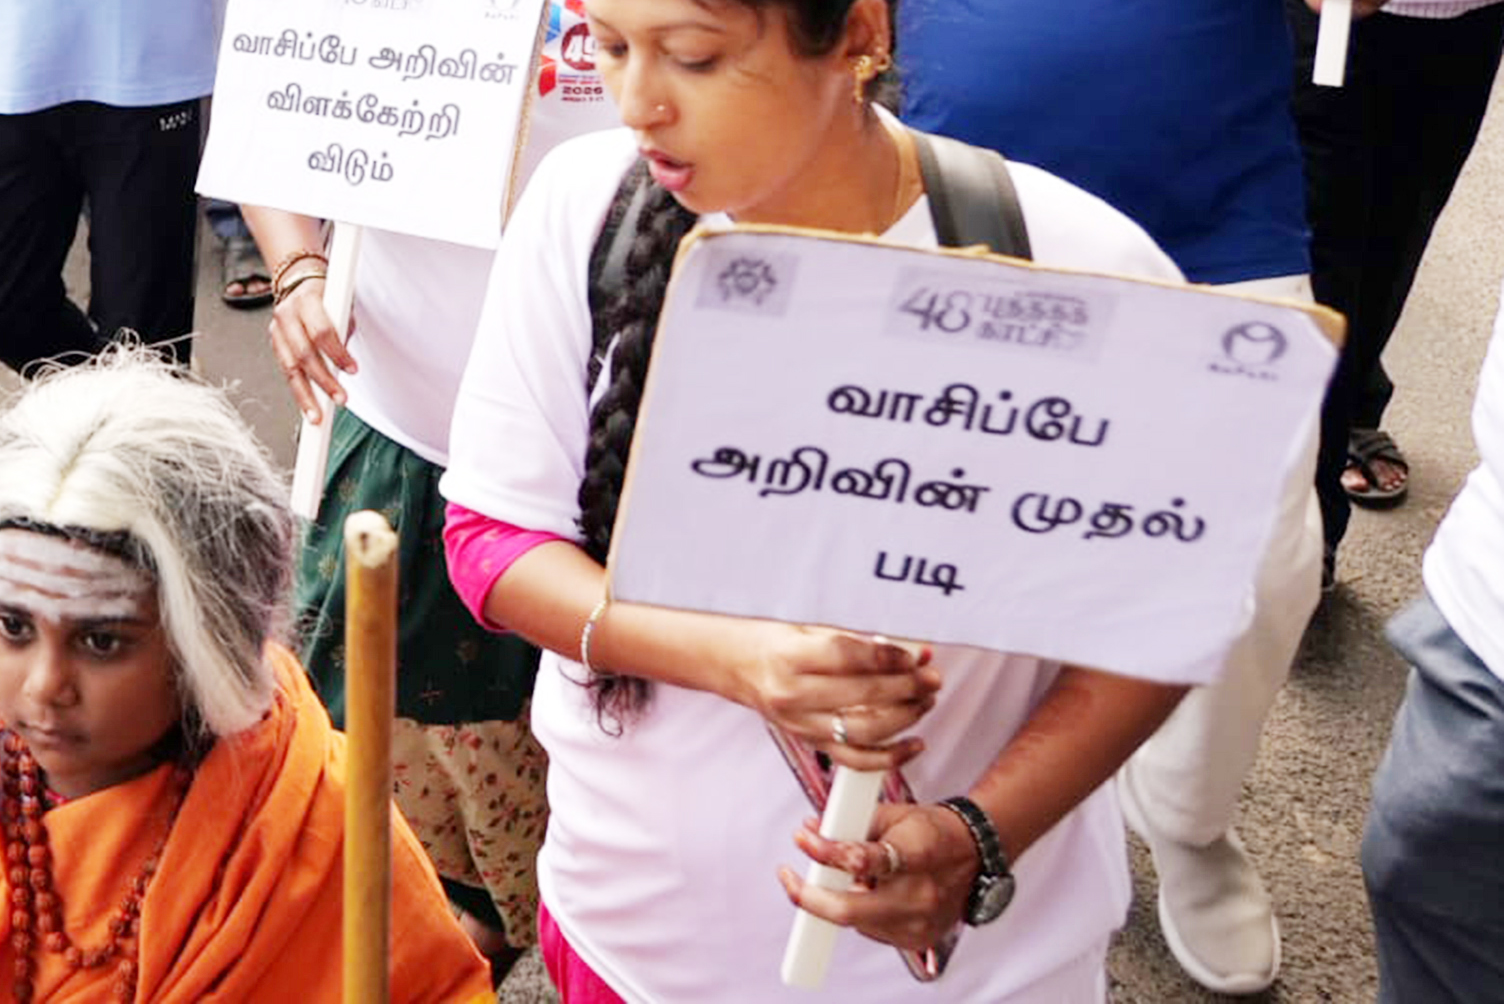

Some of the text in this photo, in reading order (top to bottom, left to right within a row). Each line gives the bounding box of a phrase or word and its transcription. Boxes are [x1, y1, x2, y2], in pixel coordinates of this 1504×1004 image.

[233, 29, 518, 85] வாசிப்பே அறிவின்
[267, 82, 461, 142] விளக்கேற்றி
[307, 143, 394, 186] விடும்
[826, 382, 1111, 449] வாசிப்பே
[691, 445, 1208, 545] அறிவின் முதல்
[873, 549, 966, 597] படி
